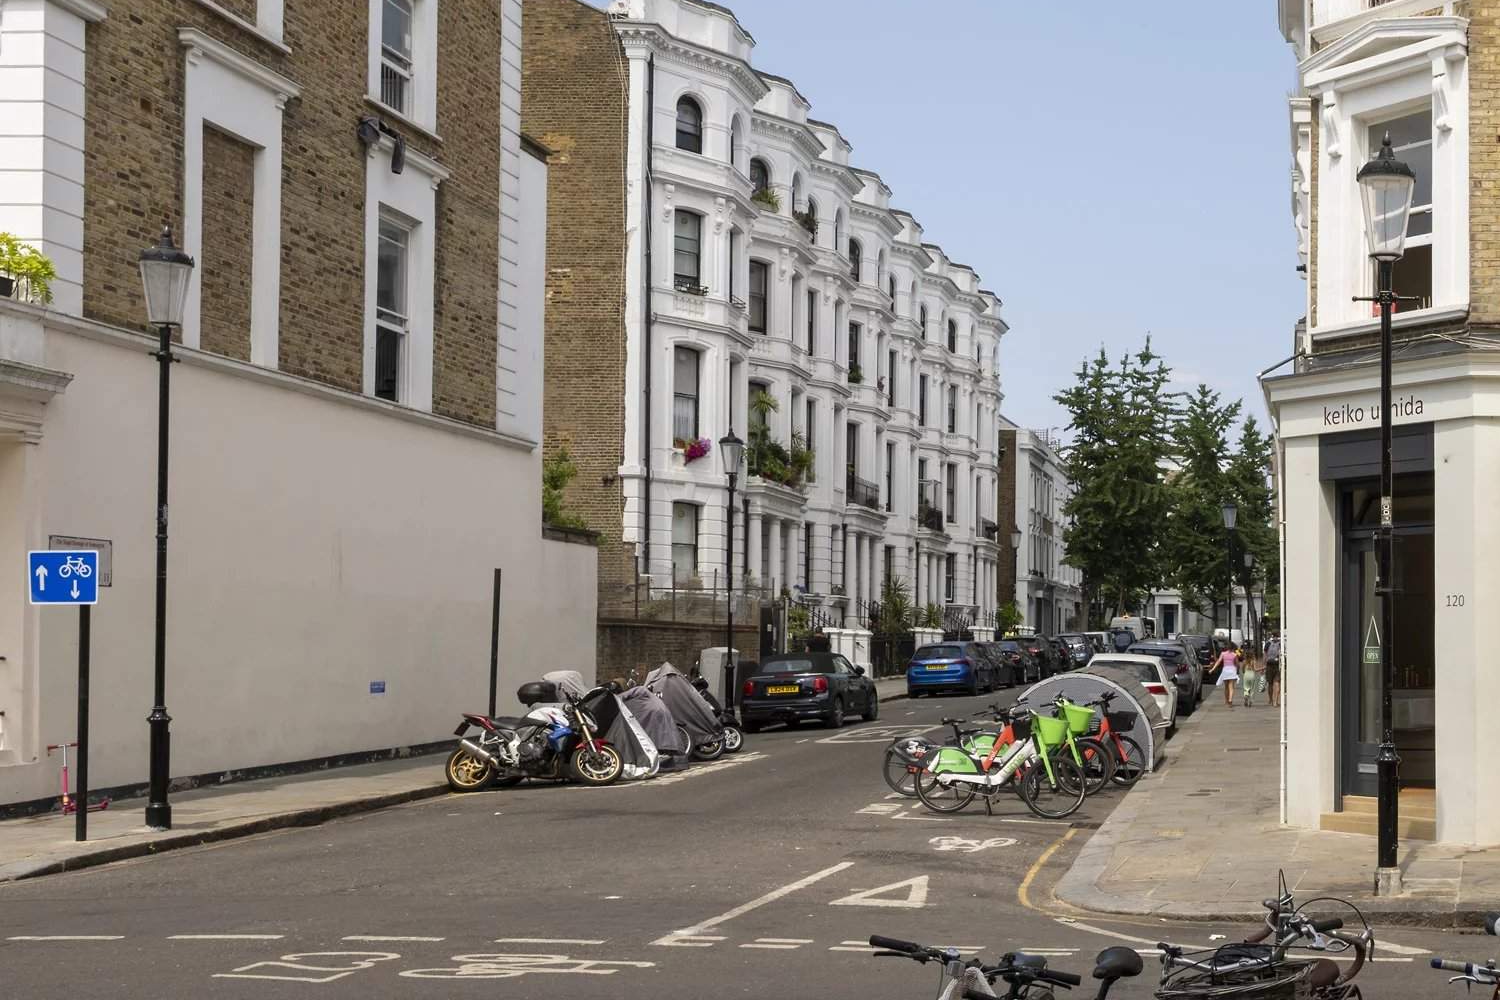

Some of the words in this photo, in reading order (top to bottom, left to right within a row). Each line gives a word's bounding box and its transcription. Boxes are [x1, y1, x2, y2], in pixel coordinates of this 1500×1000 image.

[1323, 403, 1364, 426] keiko
[1370, 395, 1424, 420] uida
[1446, 594, 1465, 607] 120
